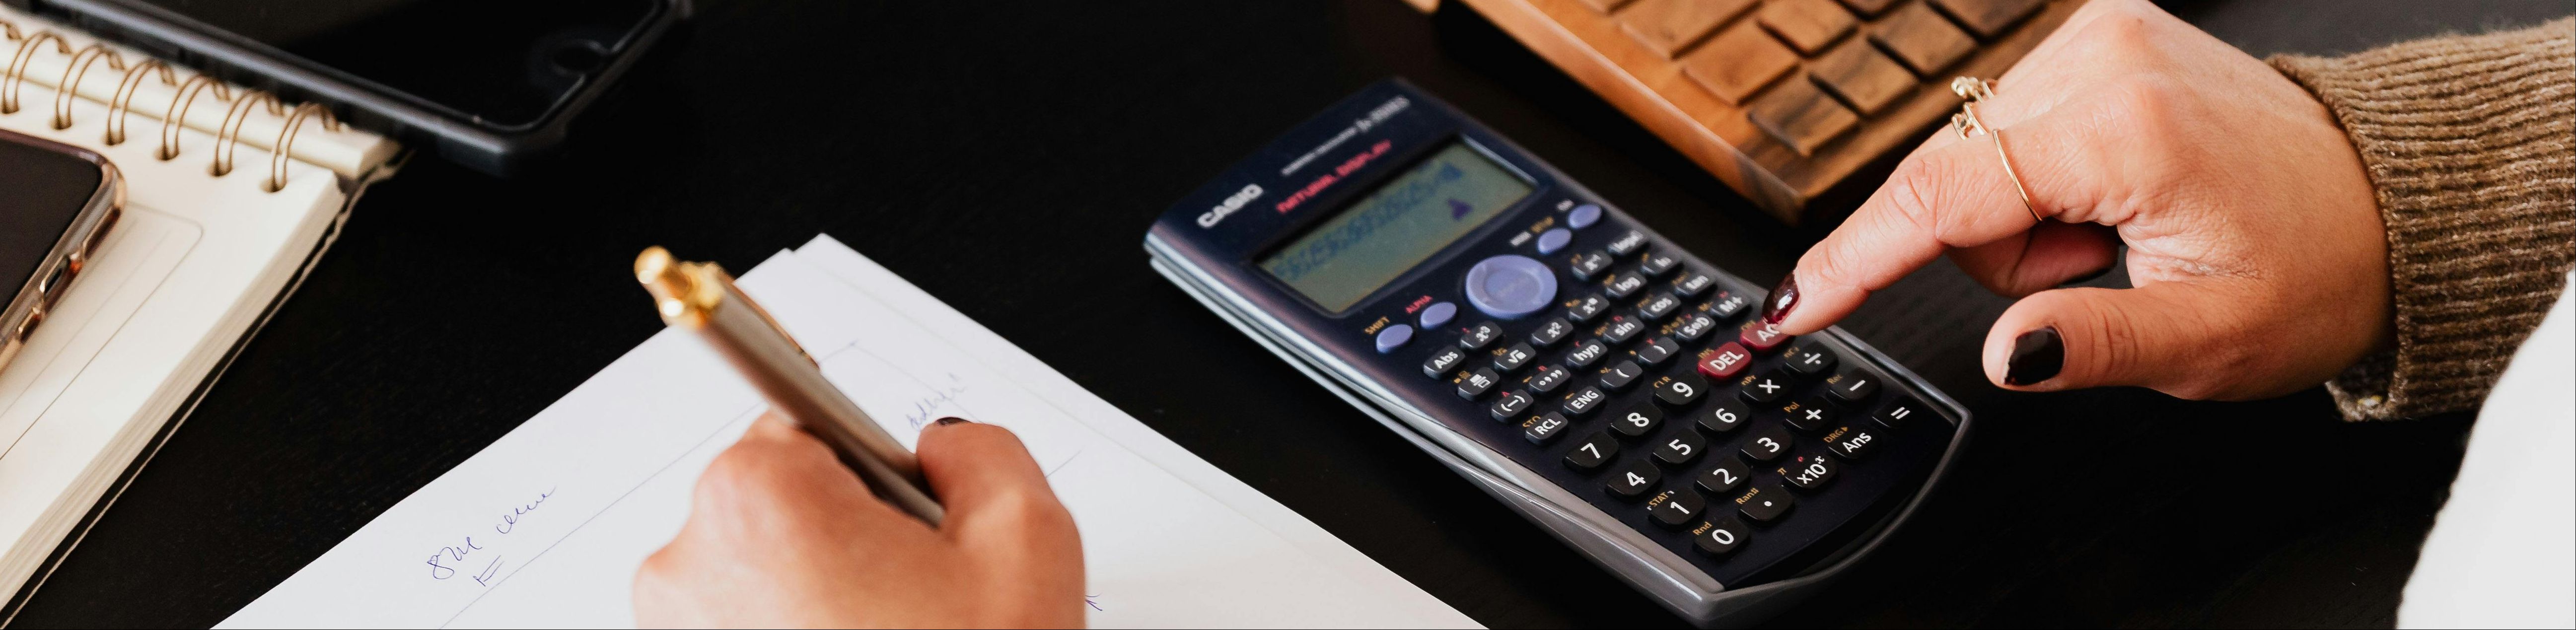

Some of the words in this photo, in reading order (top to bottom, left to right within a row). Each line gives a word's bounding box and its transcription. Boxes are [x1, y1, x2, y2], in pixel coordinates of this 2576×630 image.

[1197, 183, 1264, 229] CASIO
[1615, 277, 1641, 291] log
[1685, 275, 1709, 290] tan
[1650, 298, 1672, 312] cos
[1719, 296, 1743, 312] M+
[1364, 316, 1389, 335] SHIFT
[1614, 322, 1635, 336] sin
[1434, 351, 1458, 369] Abs
[1573, 345, 1600, 361] hyp
[1710, 350, 1744, 371] DEL
[1672, 382, 1693, 397] 9
[1571, 390, 1599, 410] ENG
[1784, 402, 1800, 413] Pol
[1627, 413, 1649, 427] 8
[1716, 408, 1736, 423] 6
[1805, 409, 1822, 420] +
[1890, 406, 1911, 420] =
[1534, 419, 1562, 435] RCL
[1580, 442, 1601, 459] 7
[1668, 439, 1691, 455] 5
[1757, 437, 1780, 453] 3
[1842, 432, 1872, 453] Ans
[1626, 472, 1646, 487] 4
[1713, 468, 1737, 485] 2
[1648, 491, 1669, 507] STAT
[1670, 501, 1690, 514] 1
[1692, 521, 1713, 536] Rnd
[1712, 529, 1734, 545] 0
